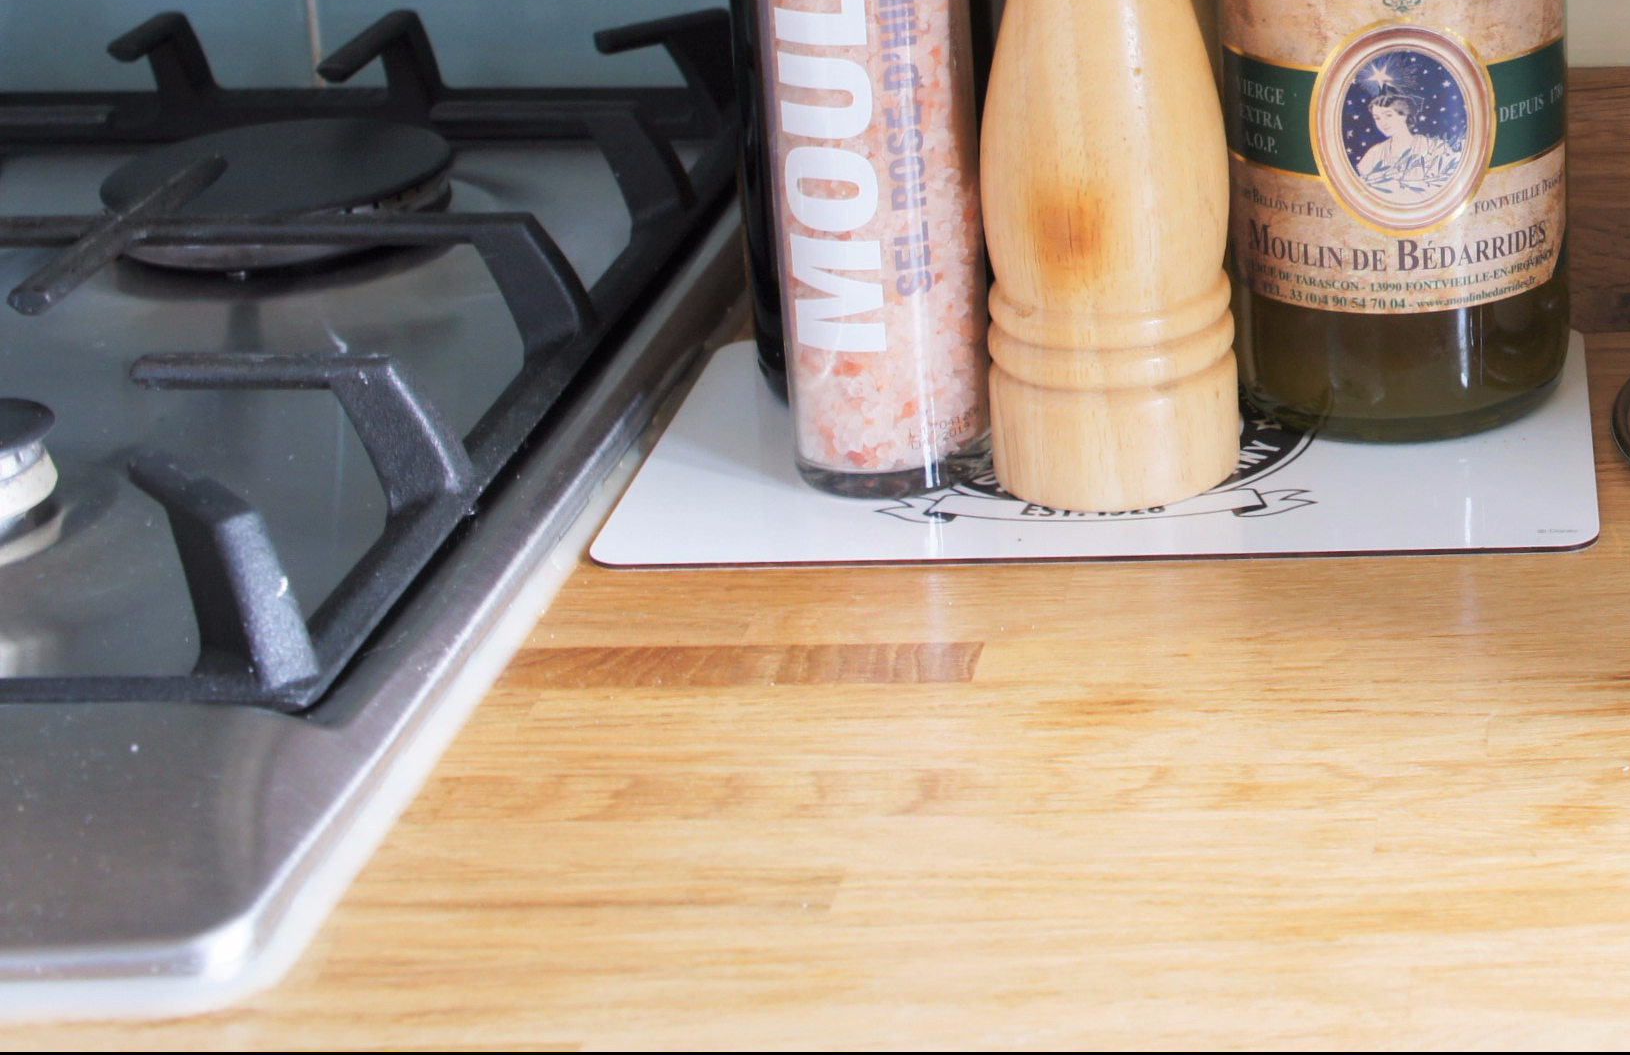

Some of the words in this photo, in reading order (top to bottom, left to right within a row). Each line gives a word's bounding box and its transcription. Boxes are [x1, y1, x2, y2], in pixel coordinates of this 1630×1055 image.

[1236, 75, 1286, 106] VIERGE
[1240, 103, 1284, 131] EXTRA
[1500, 93, 1545, 123] DEPUIS
[1291, 203, 1304, 214] ET
[1306, 201, 1334, 220] FILS
[1474, 183, 1543, 215] FONTVIEILLE
[894, 221, 932, 297] SEL
[1248, 217, 1345, 270] MOULIN
[1352, 247, 1388, 272] DE
[1397, 219, 1547, 272] BÉDARRIDES
[1295, 274, 1359, 292] TARASCON
[1370, 281, 1402, 293] 13990
[1332, 295, 1347, 307] 90
[1351, 297, 1366, 309] 54
[1371, 298, 1386, 310] 70
[1390, 298, 1406, 309] 04
